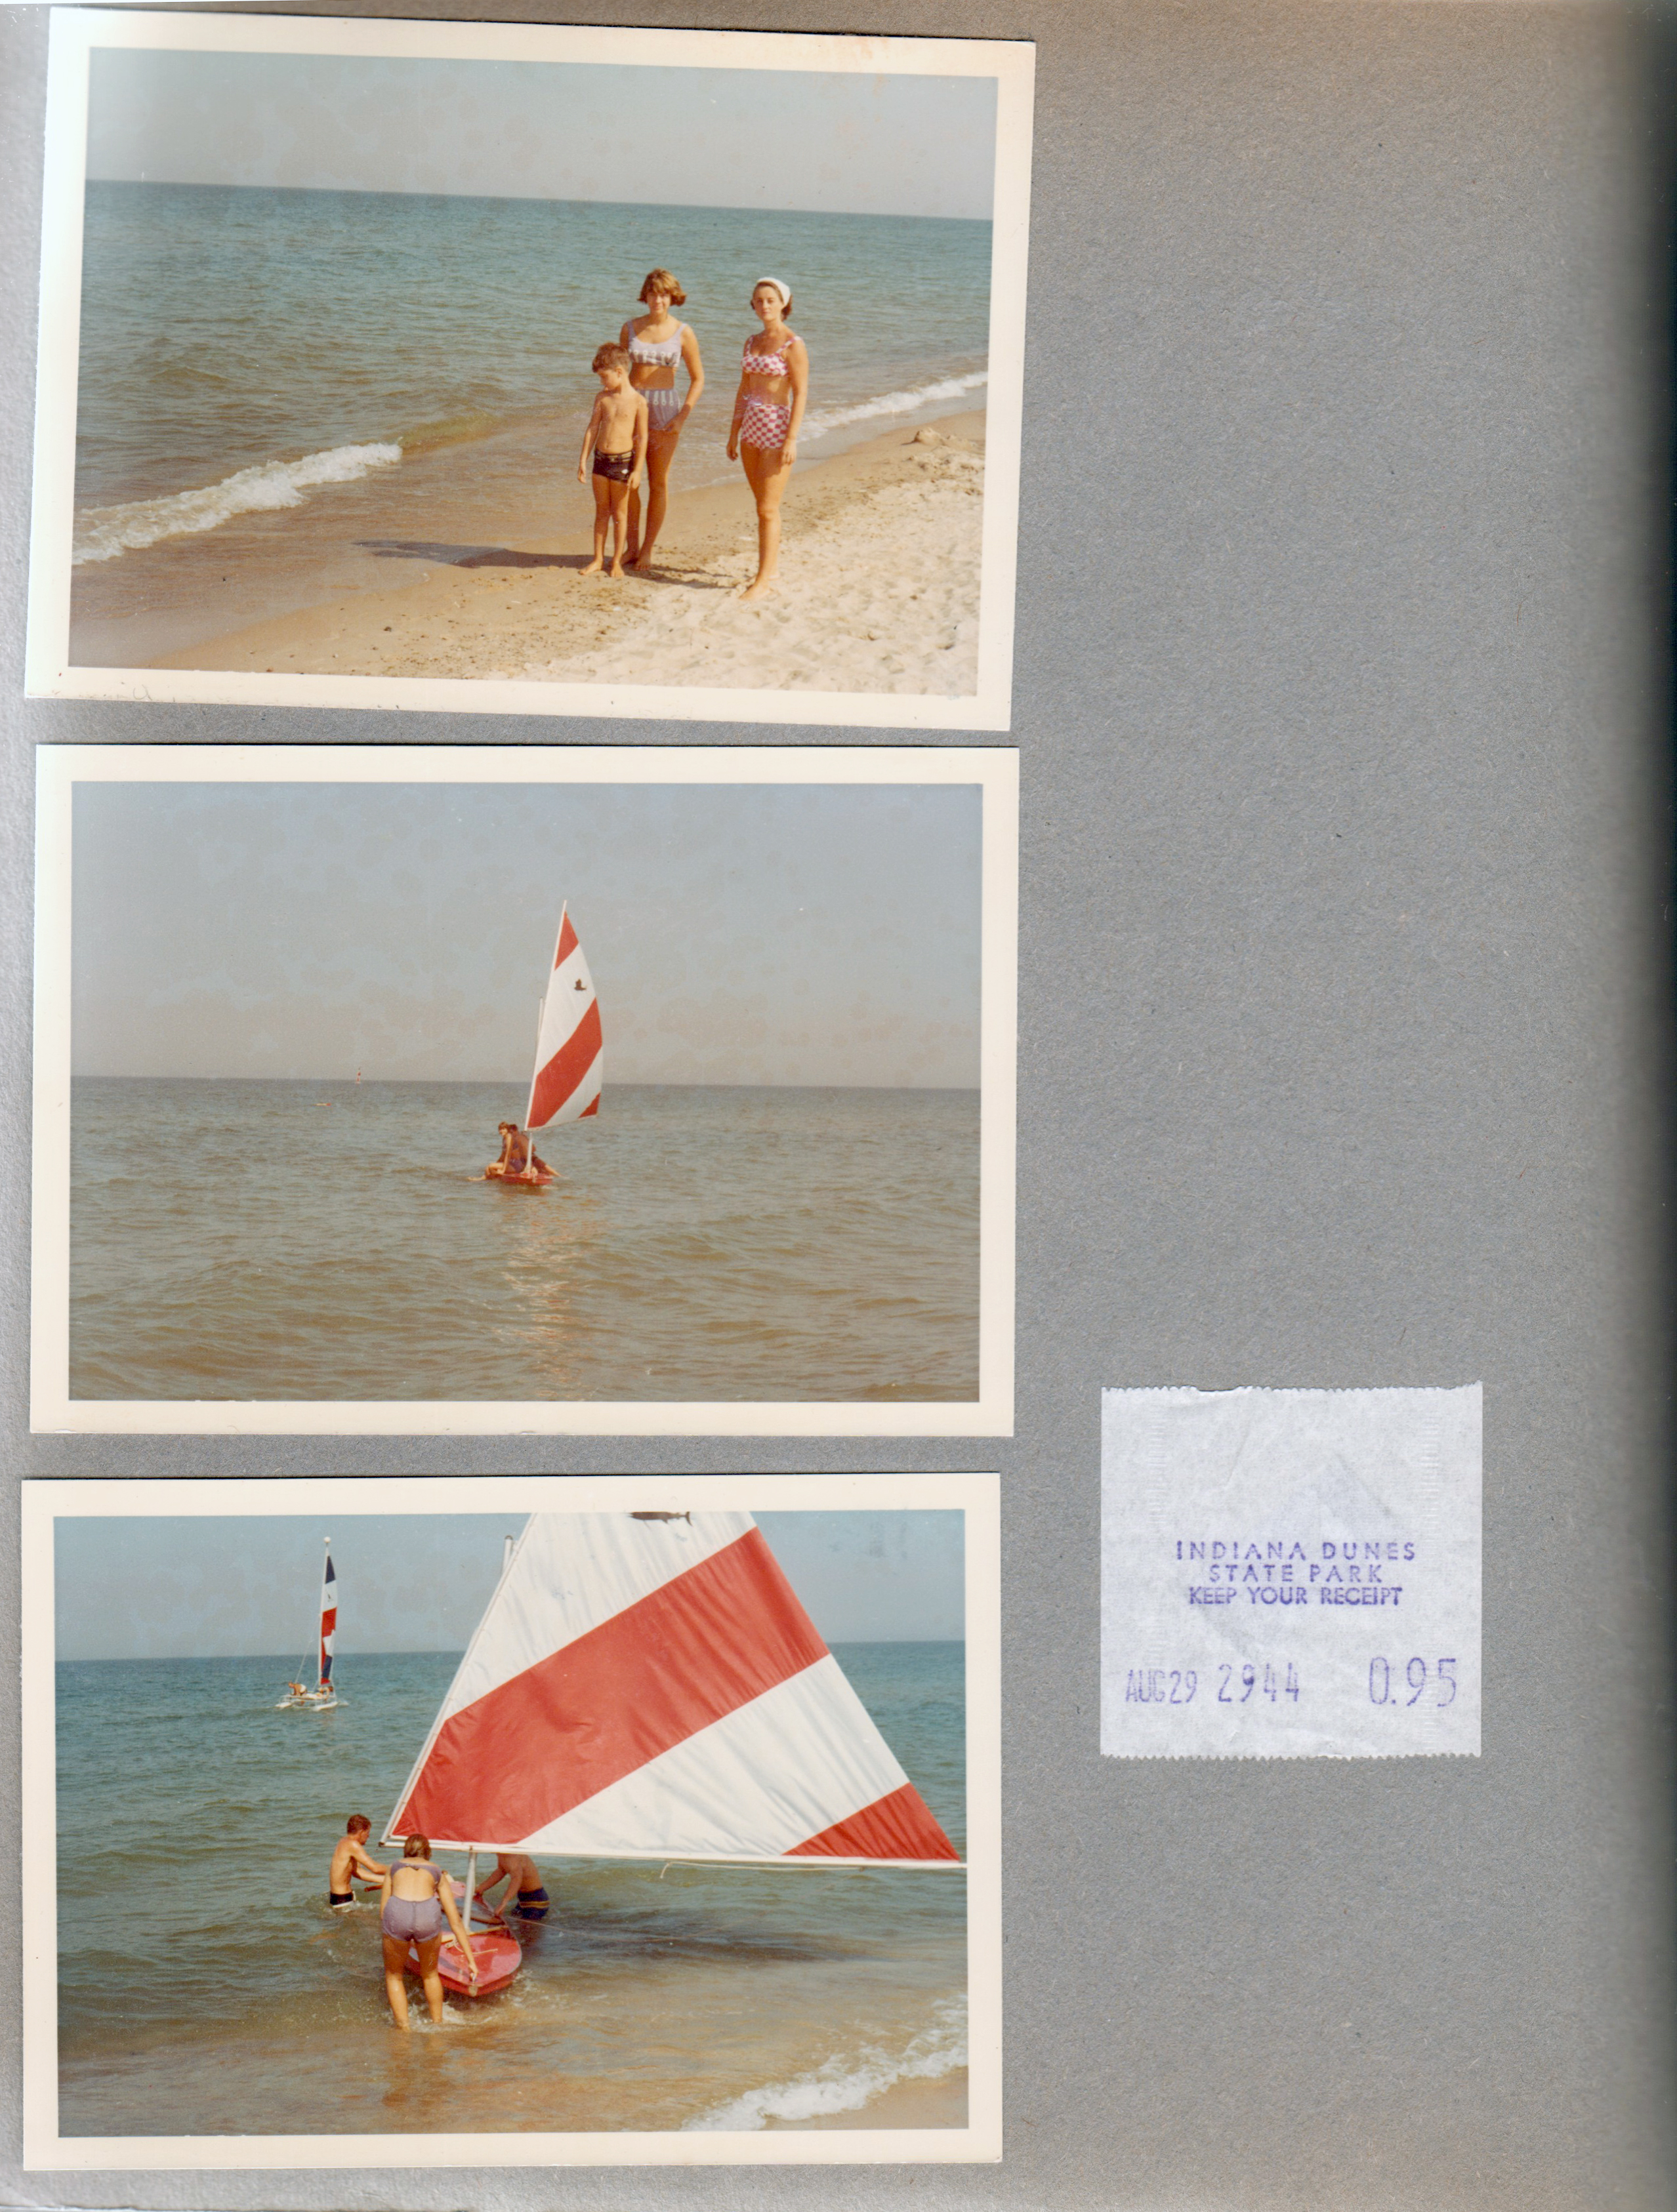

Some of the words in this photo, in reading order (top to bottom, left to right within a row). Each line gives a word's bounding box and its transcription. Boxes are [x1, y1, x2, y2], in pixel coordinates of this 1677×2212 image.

[1176, 1540, 1306, 1561] INDIANA
[1322, 1542, 1415, 1561] DUNES
[1209, 1564, 1293, 1583] STATE
[1310, 1564, 1382, 1583] PARK
[1190, 1586, 1237, 1605] KEEP
[1247, 1586, 1308, 1605] YOUR
[1320, 1586, 1403, 1606] RECEIPT
[1218, 1663, 1300, 1703] 2944
[1369, 1657, 1457, 1708] 0.95
